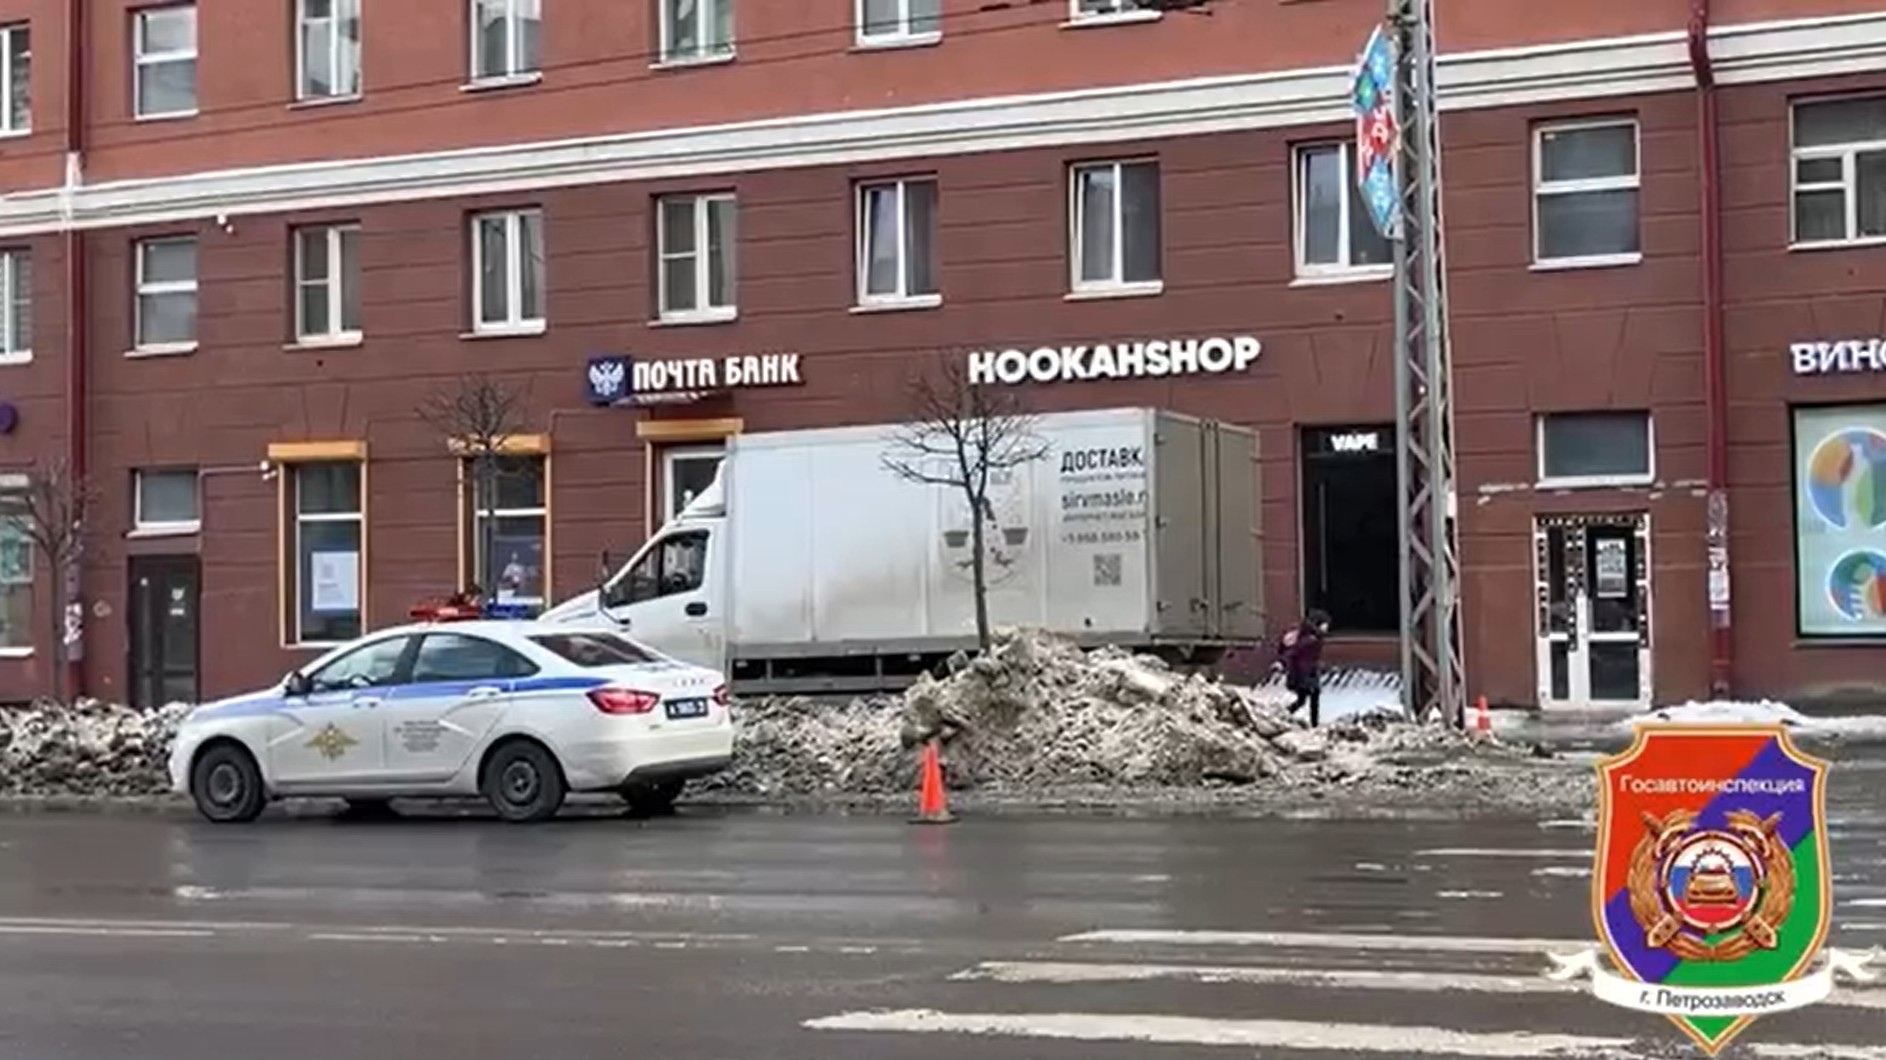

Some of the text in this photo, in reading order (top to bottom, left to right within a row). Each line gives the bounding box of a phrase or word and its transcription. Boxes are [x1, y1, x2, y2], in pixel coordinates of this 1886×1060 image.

[632, 353, 800, 391] ПОЧТА БАНК
[968, 336, 1261, 384] HOOKAHSHOP
[1790, 338, 1886, 374] ВИН
[1330, 432, 1379, 452] VAPE
